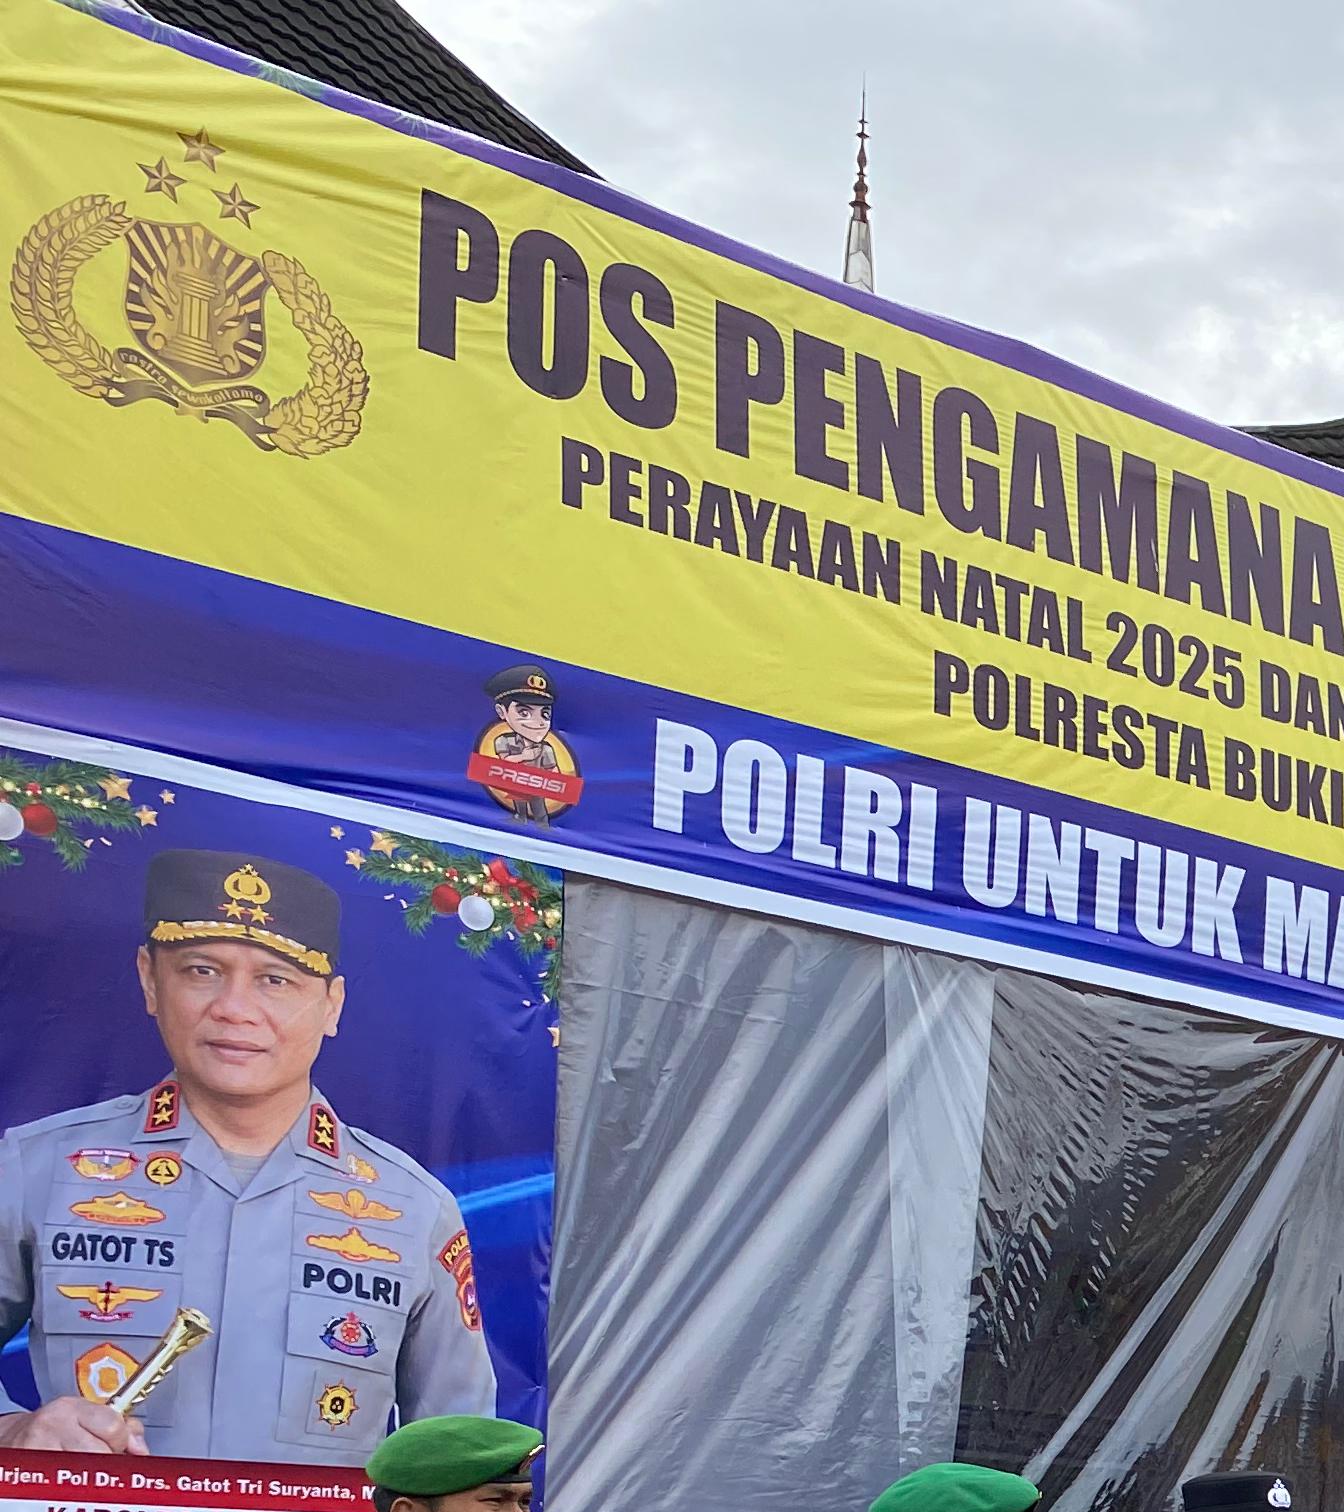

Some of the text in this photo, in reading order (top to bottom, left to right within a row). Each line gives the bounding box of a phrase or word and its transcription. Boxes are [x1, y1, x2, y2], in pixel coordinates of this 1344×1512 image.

[418, 187, 678, 430] POS
[561, 435, 902, 608] PERAYAAN
[920, 550, 1092, 664] NATAL
[1106, 610, 1245, 709] 2025
[932, 651, 1210, 791] POLRESTA
[488, 765, 568, 794] PRESISI
[652, 717, 938, 892] POLRI
[961, 796, 1251, 966] UNTUK
[52, 1232, 175, 1267] GATOT TS
[444, 1234, 470, 1265] POL
[303, 1262, 401, 1307] POLRI
[57, 1469, 88, 1486] Pol
[95, 1472, 125, 1488] Dr.
[131, 1473, 171, 1491] Drs.
[176, 1476, 231, 1493] Gatot
[237, 1479, 263, 1496] Tri
[268, 1481, 356, 1502] Suryanta,
